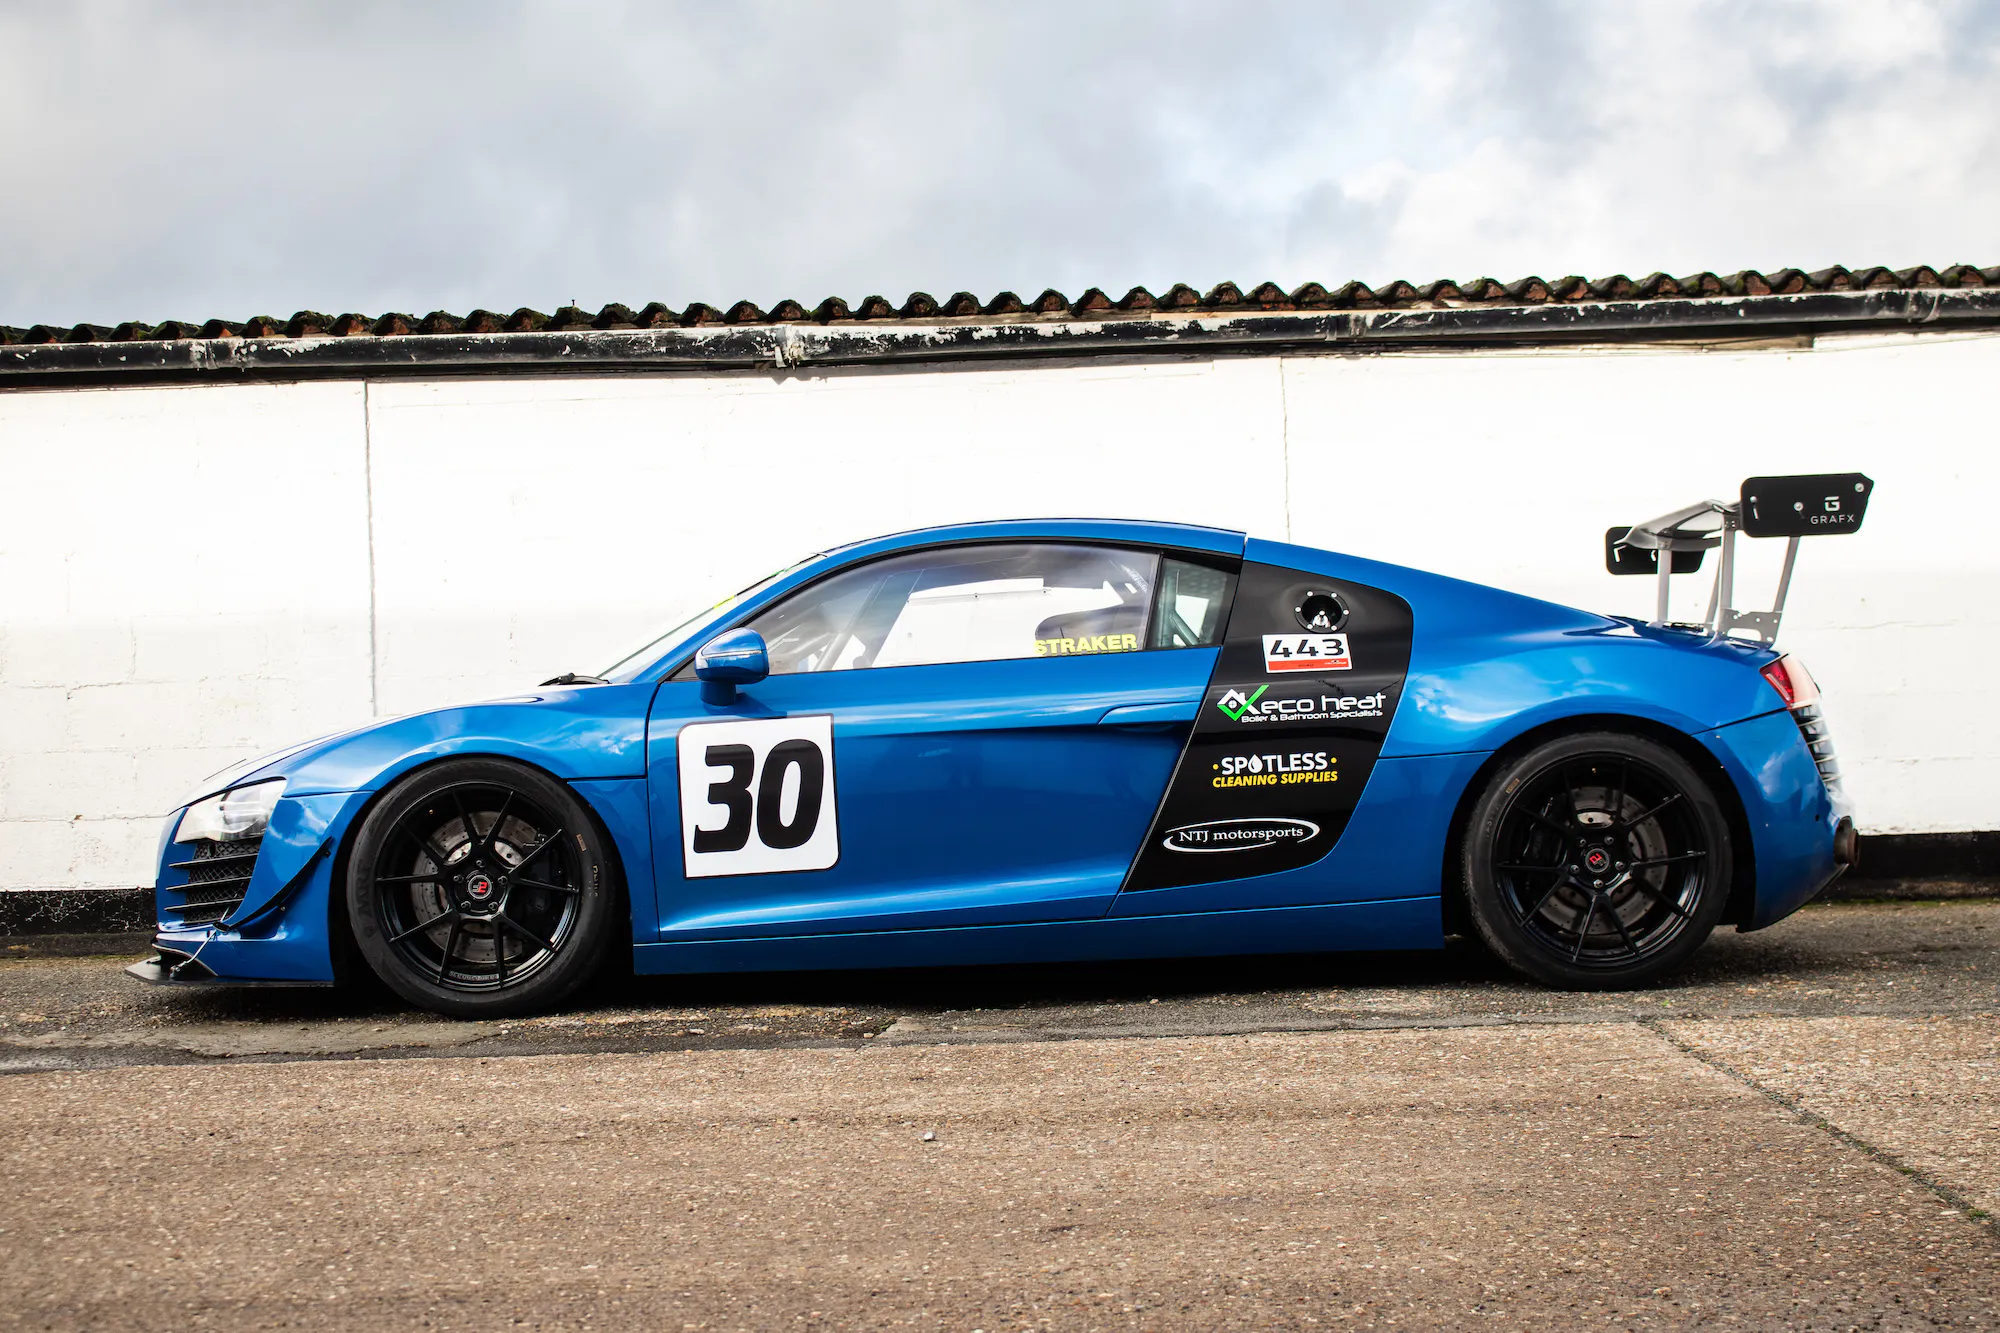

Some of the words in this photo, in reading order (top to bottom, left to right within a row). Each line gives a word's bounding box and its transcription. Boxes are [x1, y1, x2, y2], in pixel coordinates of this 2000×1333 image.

[1810, 514, 1855, 525] GRAFX
[1034, 634, 1138, 655] STRAKER
[1270, 638, 1344, 657] 443
[1260, 698, 1315, 714] eco
[1321, 692, 1387, 711] heat
[1241, 714, 1269, 723] Boiler
[1270, 714, 1279, 722] &
[1280, 712, 1329, 721] Bathroom
[1329, 709, 1384, 719] Specialists
[1221, 752, 1328, 775] SPOTLESS
[1212, 774, 1278, 788] CLEANING
[1280, 771, 1338, 784] SUPPLIES
[693, 738, 824, 853] 30
[1179, 830, 1209, 842] NTJ
[1213, 827, 1304, 842] motorsports
